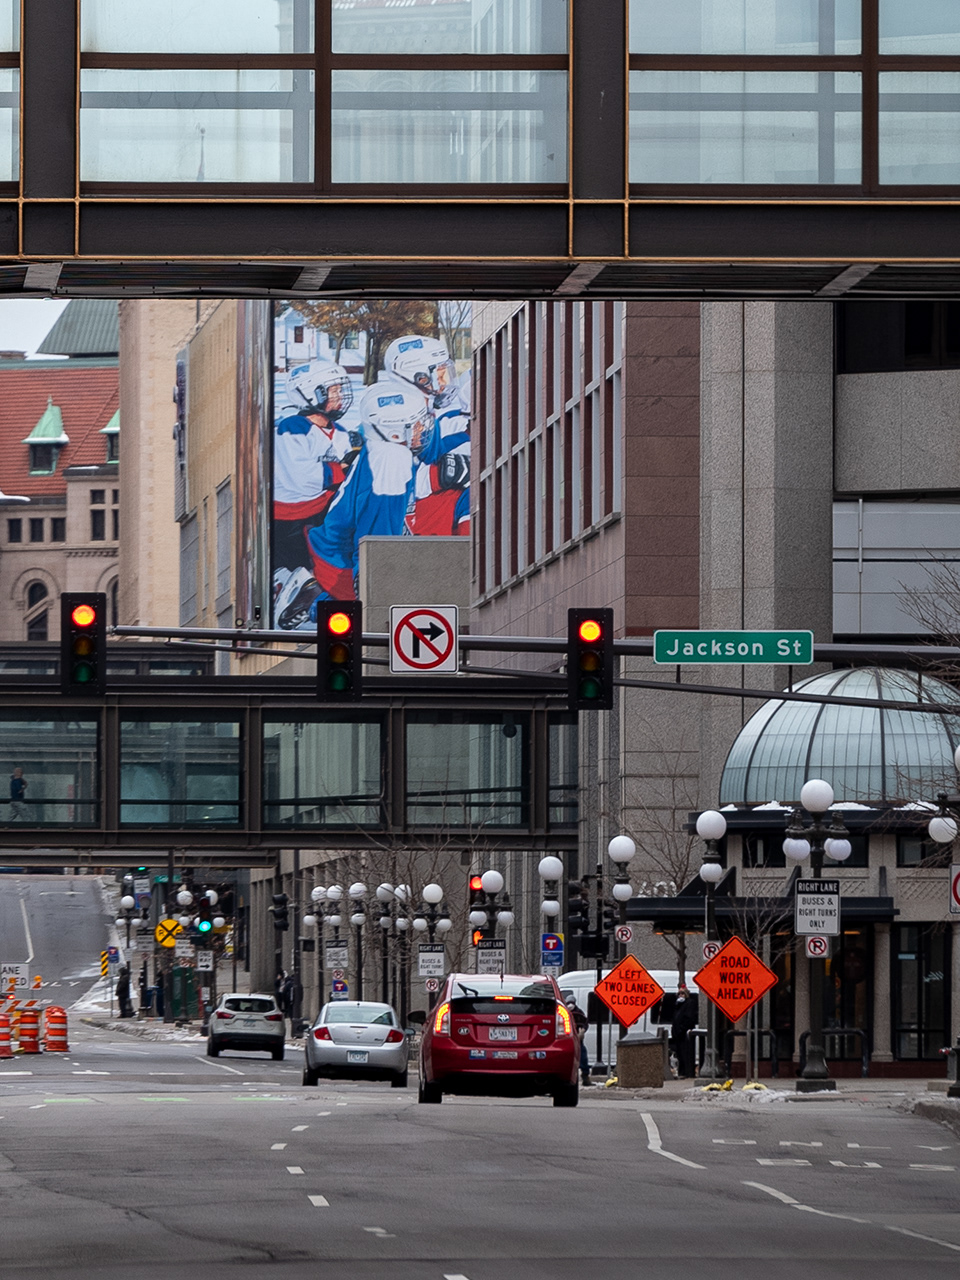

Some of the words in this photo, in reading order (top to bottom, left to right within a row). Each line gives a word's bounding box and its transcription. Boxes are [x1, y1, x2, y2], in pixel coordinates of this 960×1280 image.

[666, 639, 764, 656] Jackson
[777, 639, 802, 656] St
[798, 882, 819, 892] RIGHT
[820, 883, 838, 892] LANE
[802, 897, 824, 905] BUSES
[827, 897, 834, 905] &
[799, 908, 815, 917] RIGHT
[817, 908, 837, 917] TURNS
[809, 919, 825, 928] ONLY
[720, 956, 750, 969] ROAD
[1, 966, 20, 975] ANE
[619, 970, 642, 980] LEFT
[719, 972, 751, 984] WORK
[604, 982, 623, 992] TWO
[625, 983, 656, 994] LANES
[716, 988, 754, 1000] AHEAD
[610, 996, 647, 1007] CLOSED
